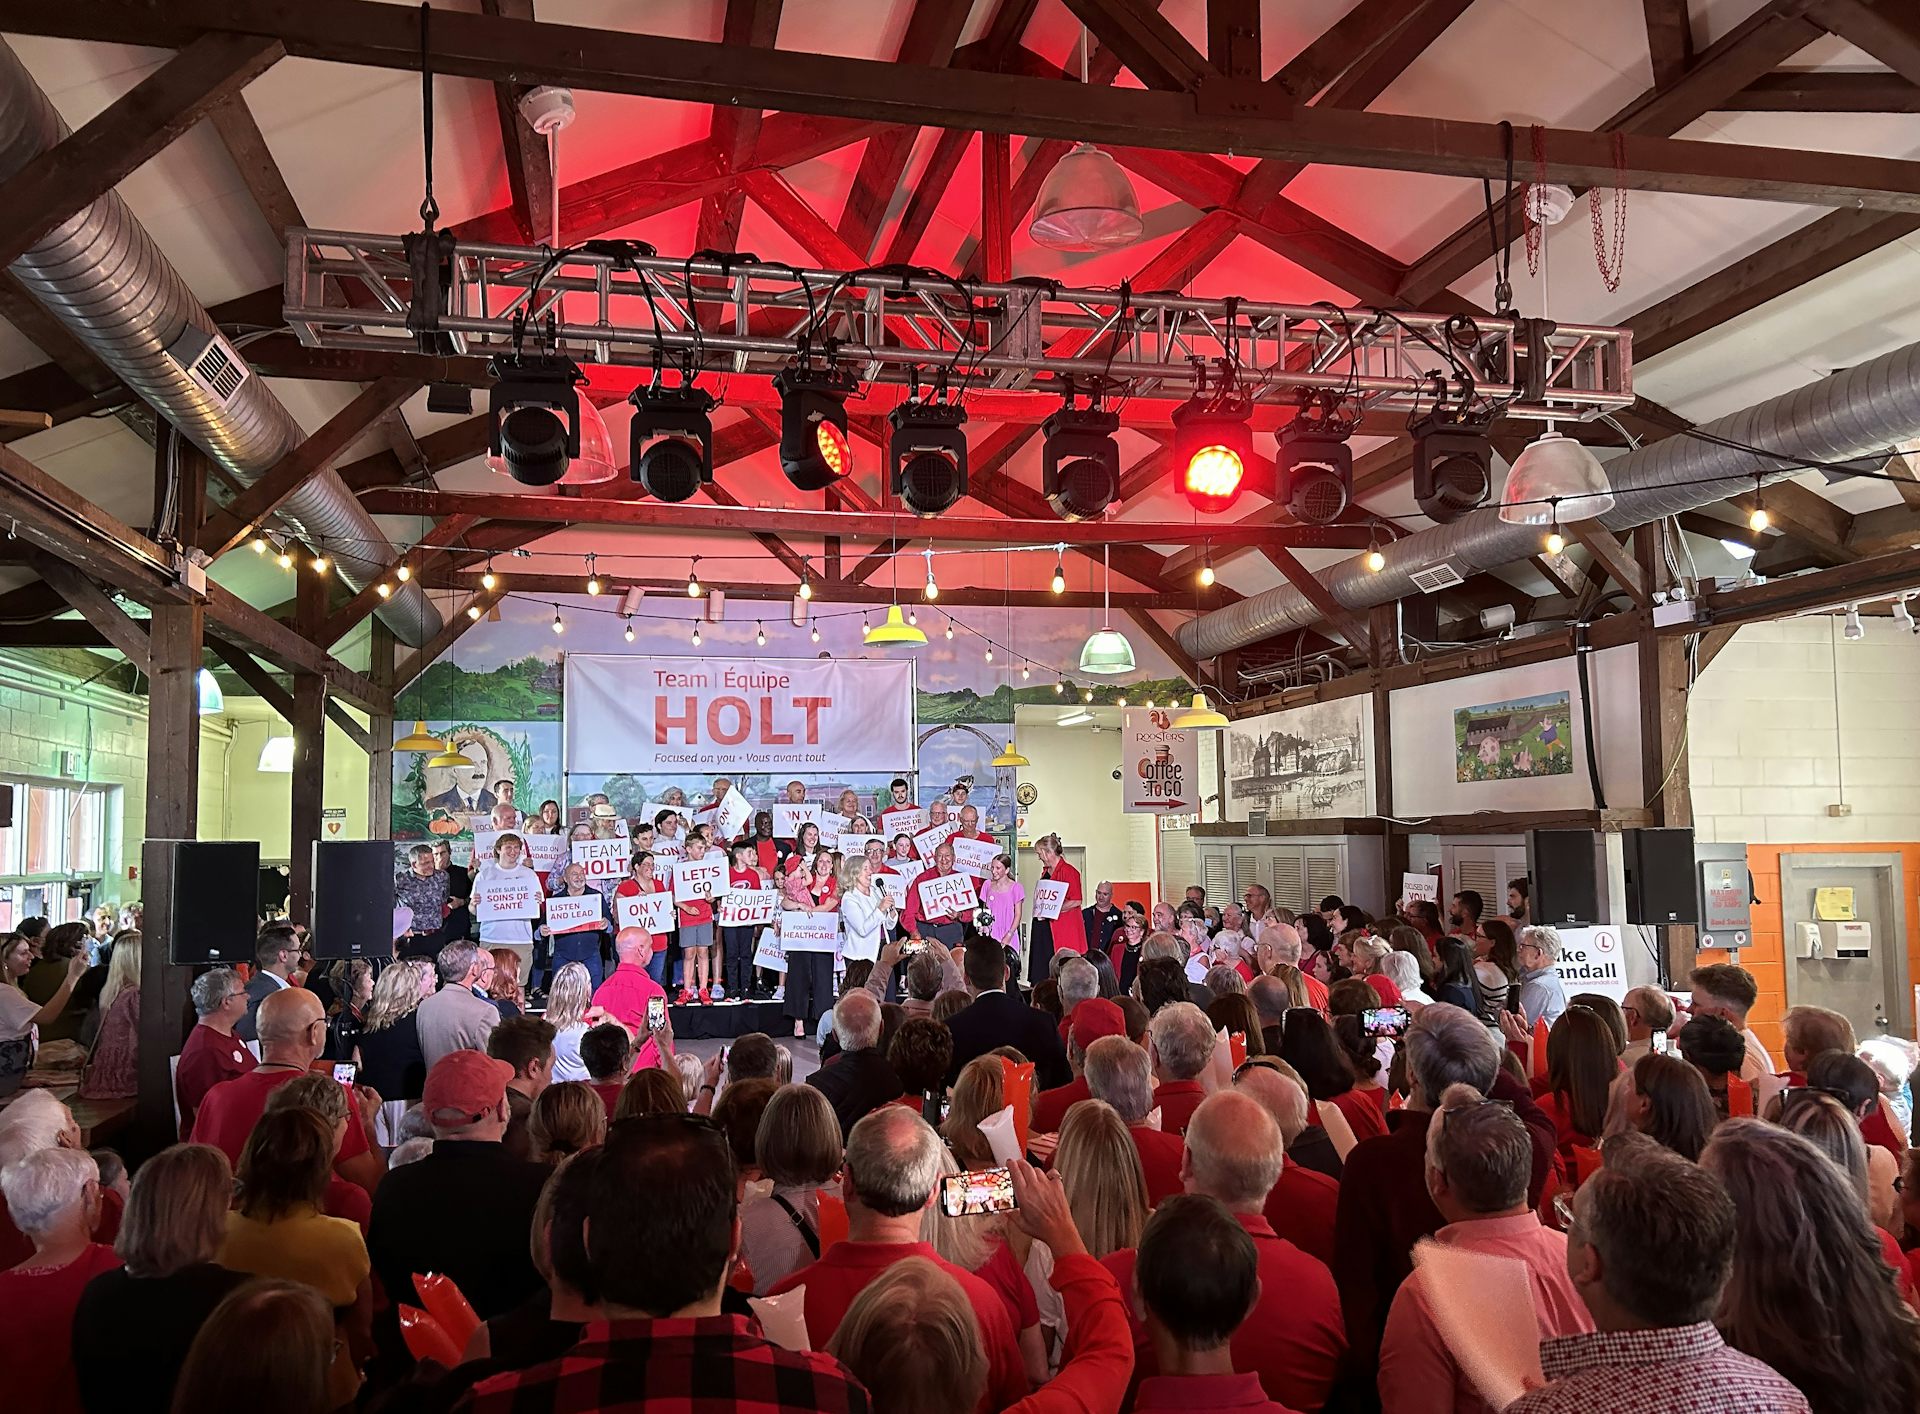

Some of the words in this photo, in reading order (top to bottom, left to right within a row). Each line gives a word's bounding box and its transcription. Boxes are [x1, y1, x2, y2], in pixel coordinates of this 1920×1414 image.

[653, 670, 707, 689] Team
[724, 666, 790, 692] Équipe
[654, 695, 832, 745] HOLT
[654, 753, 697, 764] Focused
[701, 755, 714, 763] on
[717, 754, 736, 765] you
[746, 753, 769, 763] Vous
[773, 754, 802, 763] avant
[805, 753, 826, 763] tout
[1138, 758, 1182, 779] Coffee
[805, 811, 812, 820] Y
[890, 820, 911, 828] SOINS
[580, 844, 622, 858] TEAM
[969, 853, 981, 861] VIE
[956, 858, 992, 871] BORDABL
[682, 866, 720, 881] LET'S
[693, 882, 712, 894] GO
[925, 878, 966, 897] TEAM
[487, 893, 514, 902] SOINS
[727, 891, 773, 906] ÉQUIPE
[925, 890, 972, 915] HOLT
[493, 901, 523, 911] SANTÉ
[550, 903, 580, 911] LISTEN
[629, 902, 649, 916] ON
[653, 900, 662, 912] Y
[550, 912, 569, 920] AND
[571, 910, 593, 918] LEAD
[723, 907, 772, 921] HOLT
[638, 917, 656, 928] VA
[784, 932, 835, 940] HEALTHCARE
[1556, 963, 1617, 978] andall
